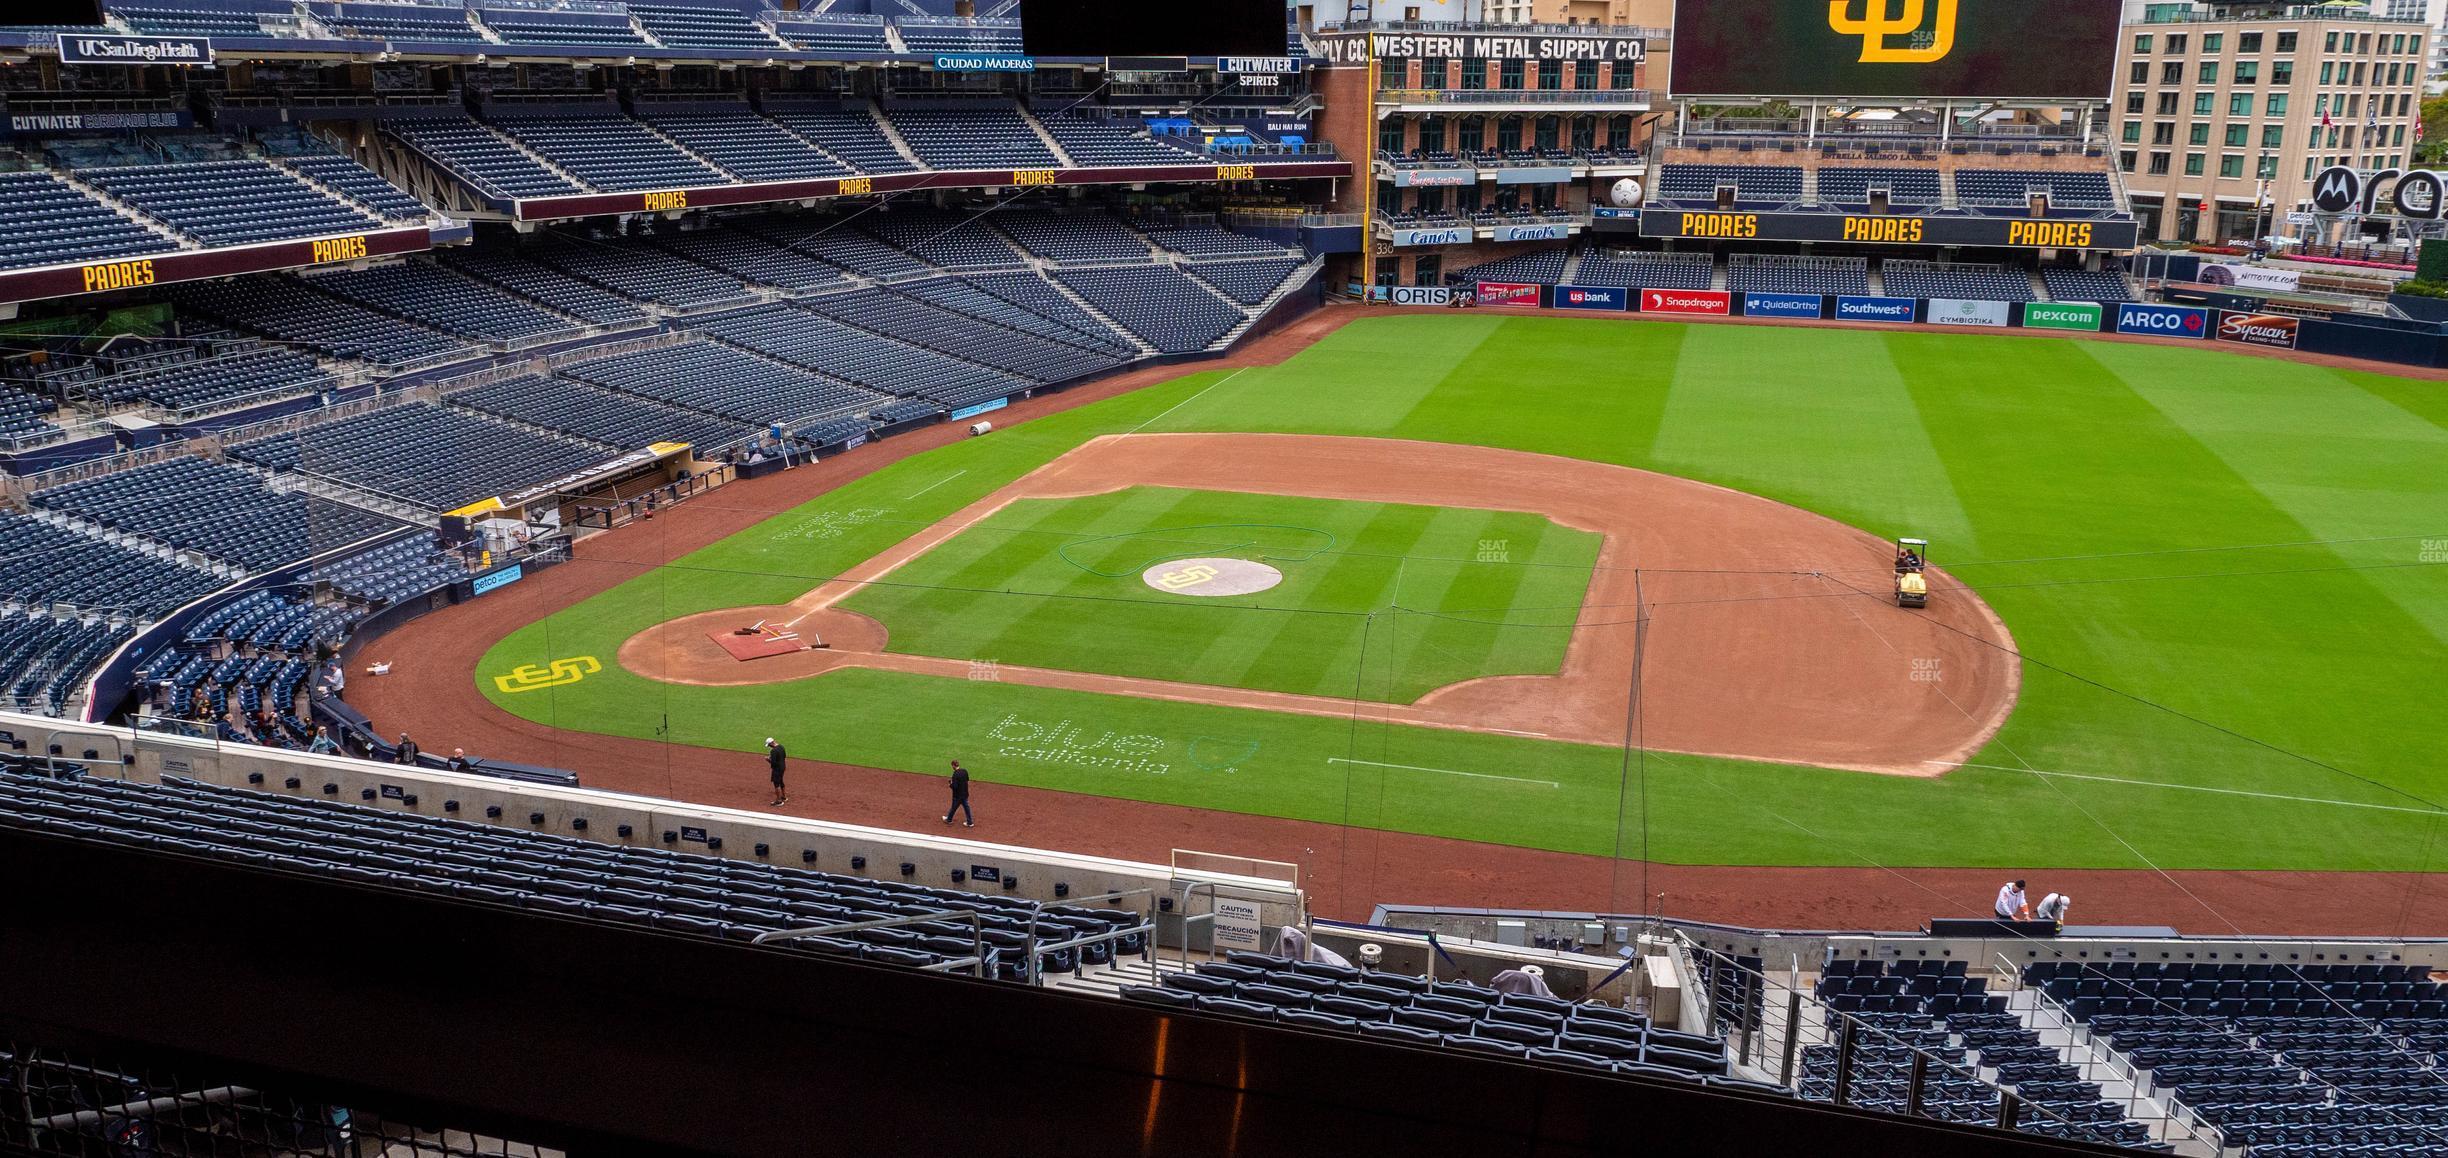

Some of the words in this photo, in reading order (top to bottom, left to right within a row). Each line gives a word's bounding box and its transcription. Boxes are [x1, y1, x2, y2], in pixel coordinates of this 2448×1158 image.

[1373, 36, 1465, 58] WESTERN
[1474, 38, 1535, 58] METAL
[1540, 39, 1609, 60] SUPPLY
[1615, 40, 1645, 60] CO.
[938, 57, 982, 69] CIUDAD
[985, 57, 1033, 69] MADERAS
[1227, 58, 1292, 72] CUTWATER
[1240, 75, 1279, 86] SPIRITS
[12, 114, 83, 130] CUTWATER
[84, 113, 149, 129] CORONADO
[150, 112, 178, 127] CLUB
[1865, 153, 1898, 161] JALISCO
[1900, 154, 1938, 162] LANDING
[1013, 170, 1055, 185] PADRES
[1217, 166, 1254, 180] PADRES
[839, 178, 871, 195] PADRES
[644, 191, 687, 210] PADRES
[1509, 225, 1556, 240] Canel's
[1681, 213, 1757, 237] PADRES
[1844, 217, 1922, 242] PADRES
[1409, 230, 1459, 244] Canel's
[2009, 222, 2092, 247] PADRES
[313, 236, 367, 263] PADRES
[1376, 242, 1394, 254] 336
[83, 260, 155, 291] PADRES
[1395, 289, 1448, 304] ORIS
[1570, 292, 1583, 301] us
[1585, 292, 1611, 302] bank
[1666, 297, 1724, 309] Snapdragon
[1762, 300, 1817, 310] QuidelOrtho
[1841, 303, 1901, 315] Southwest
[1940, 316, 1994, 325] CYMBIOTIKA
[2120, 311, 2181, 329] ARCO
[2223, 314, 2289, 341] Sycuan
[474, 575, 498, 592] petco
[986, 713, 1165, 756] blue
[1000, 746, 1170, 774] california
[1220, 904, 1253, 914] CAUTION
